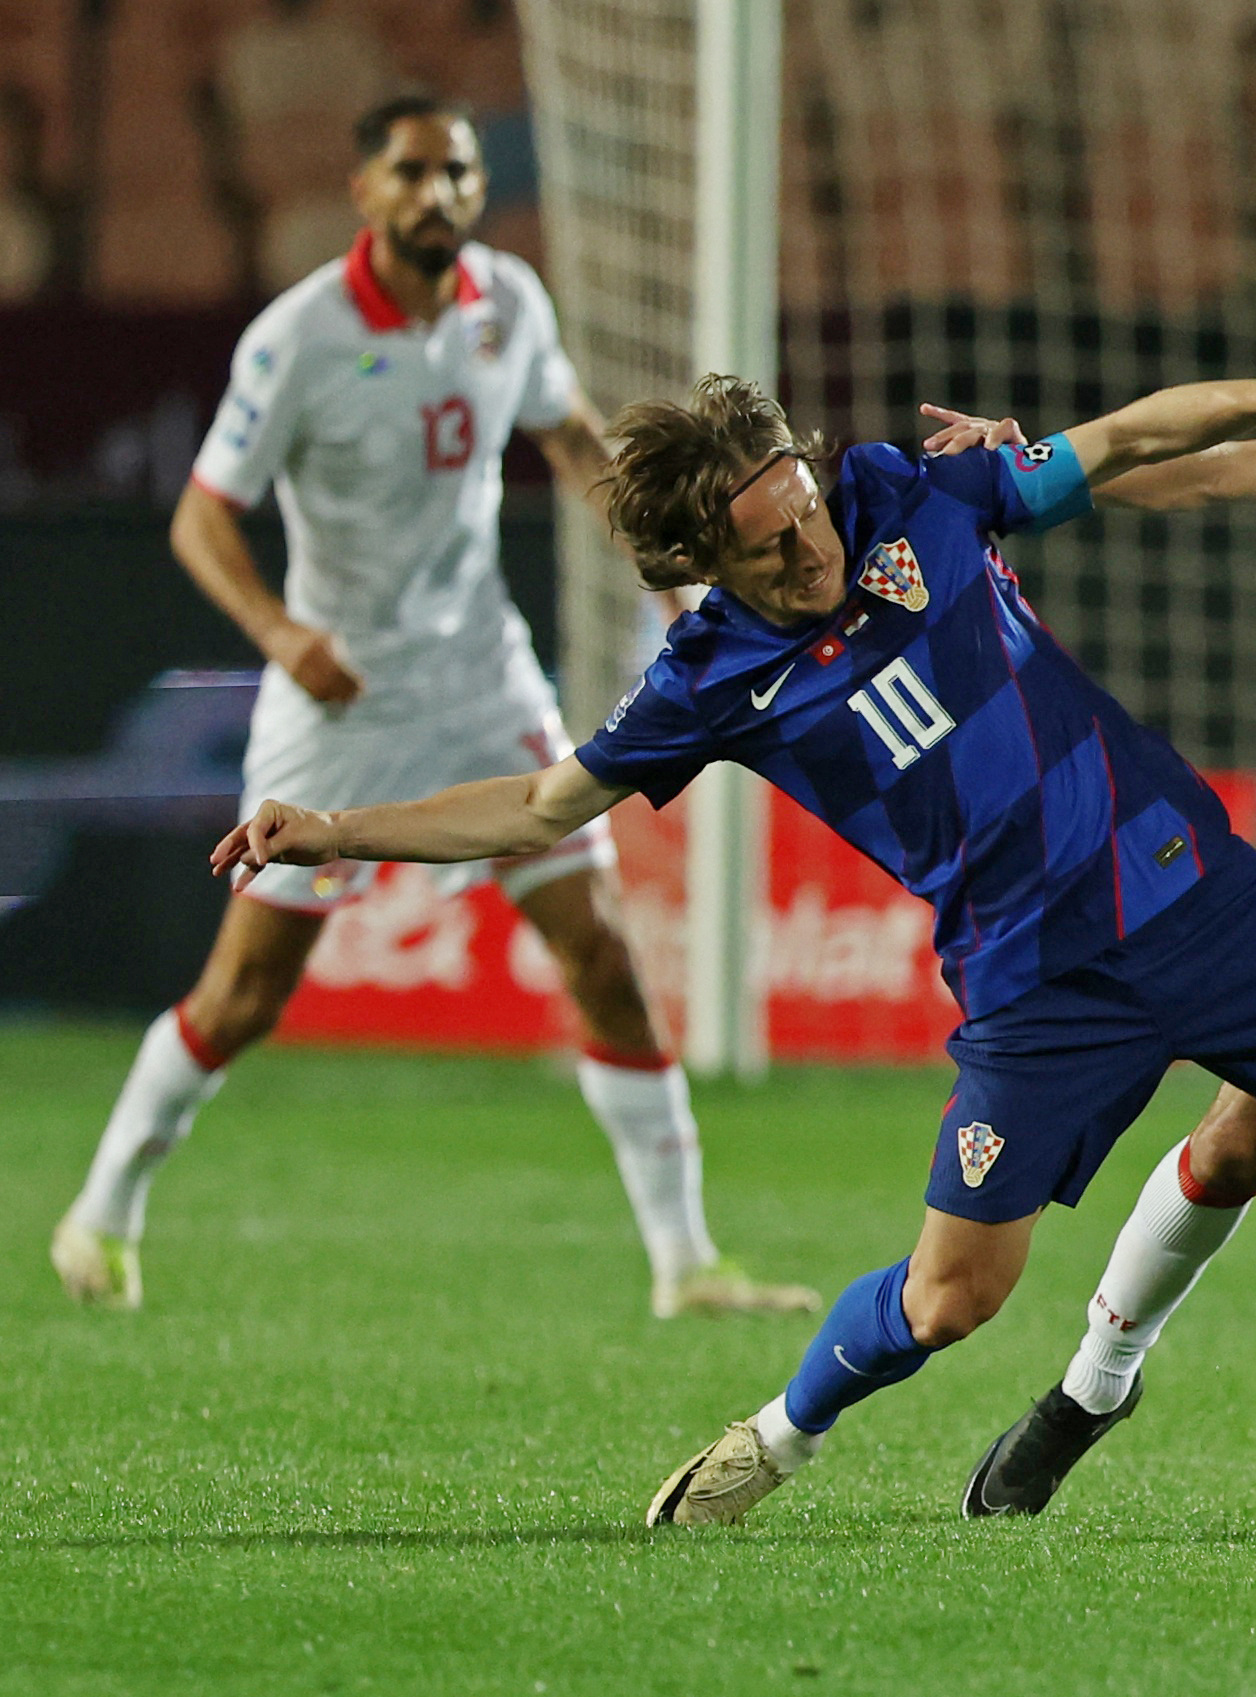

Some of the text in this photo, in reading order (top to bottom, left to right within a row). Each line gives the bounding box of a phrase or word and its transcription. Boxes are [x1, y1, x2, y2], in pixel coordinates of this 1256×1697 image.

[419, 393, 476, 473] 13
[846, 656, 957, 770] 10
[1097, 1293, 1138, 1333] FTF
